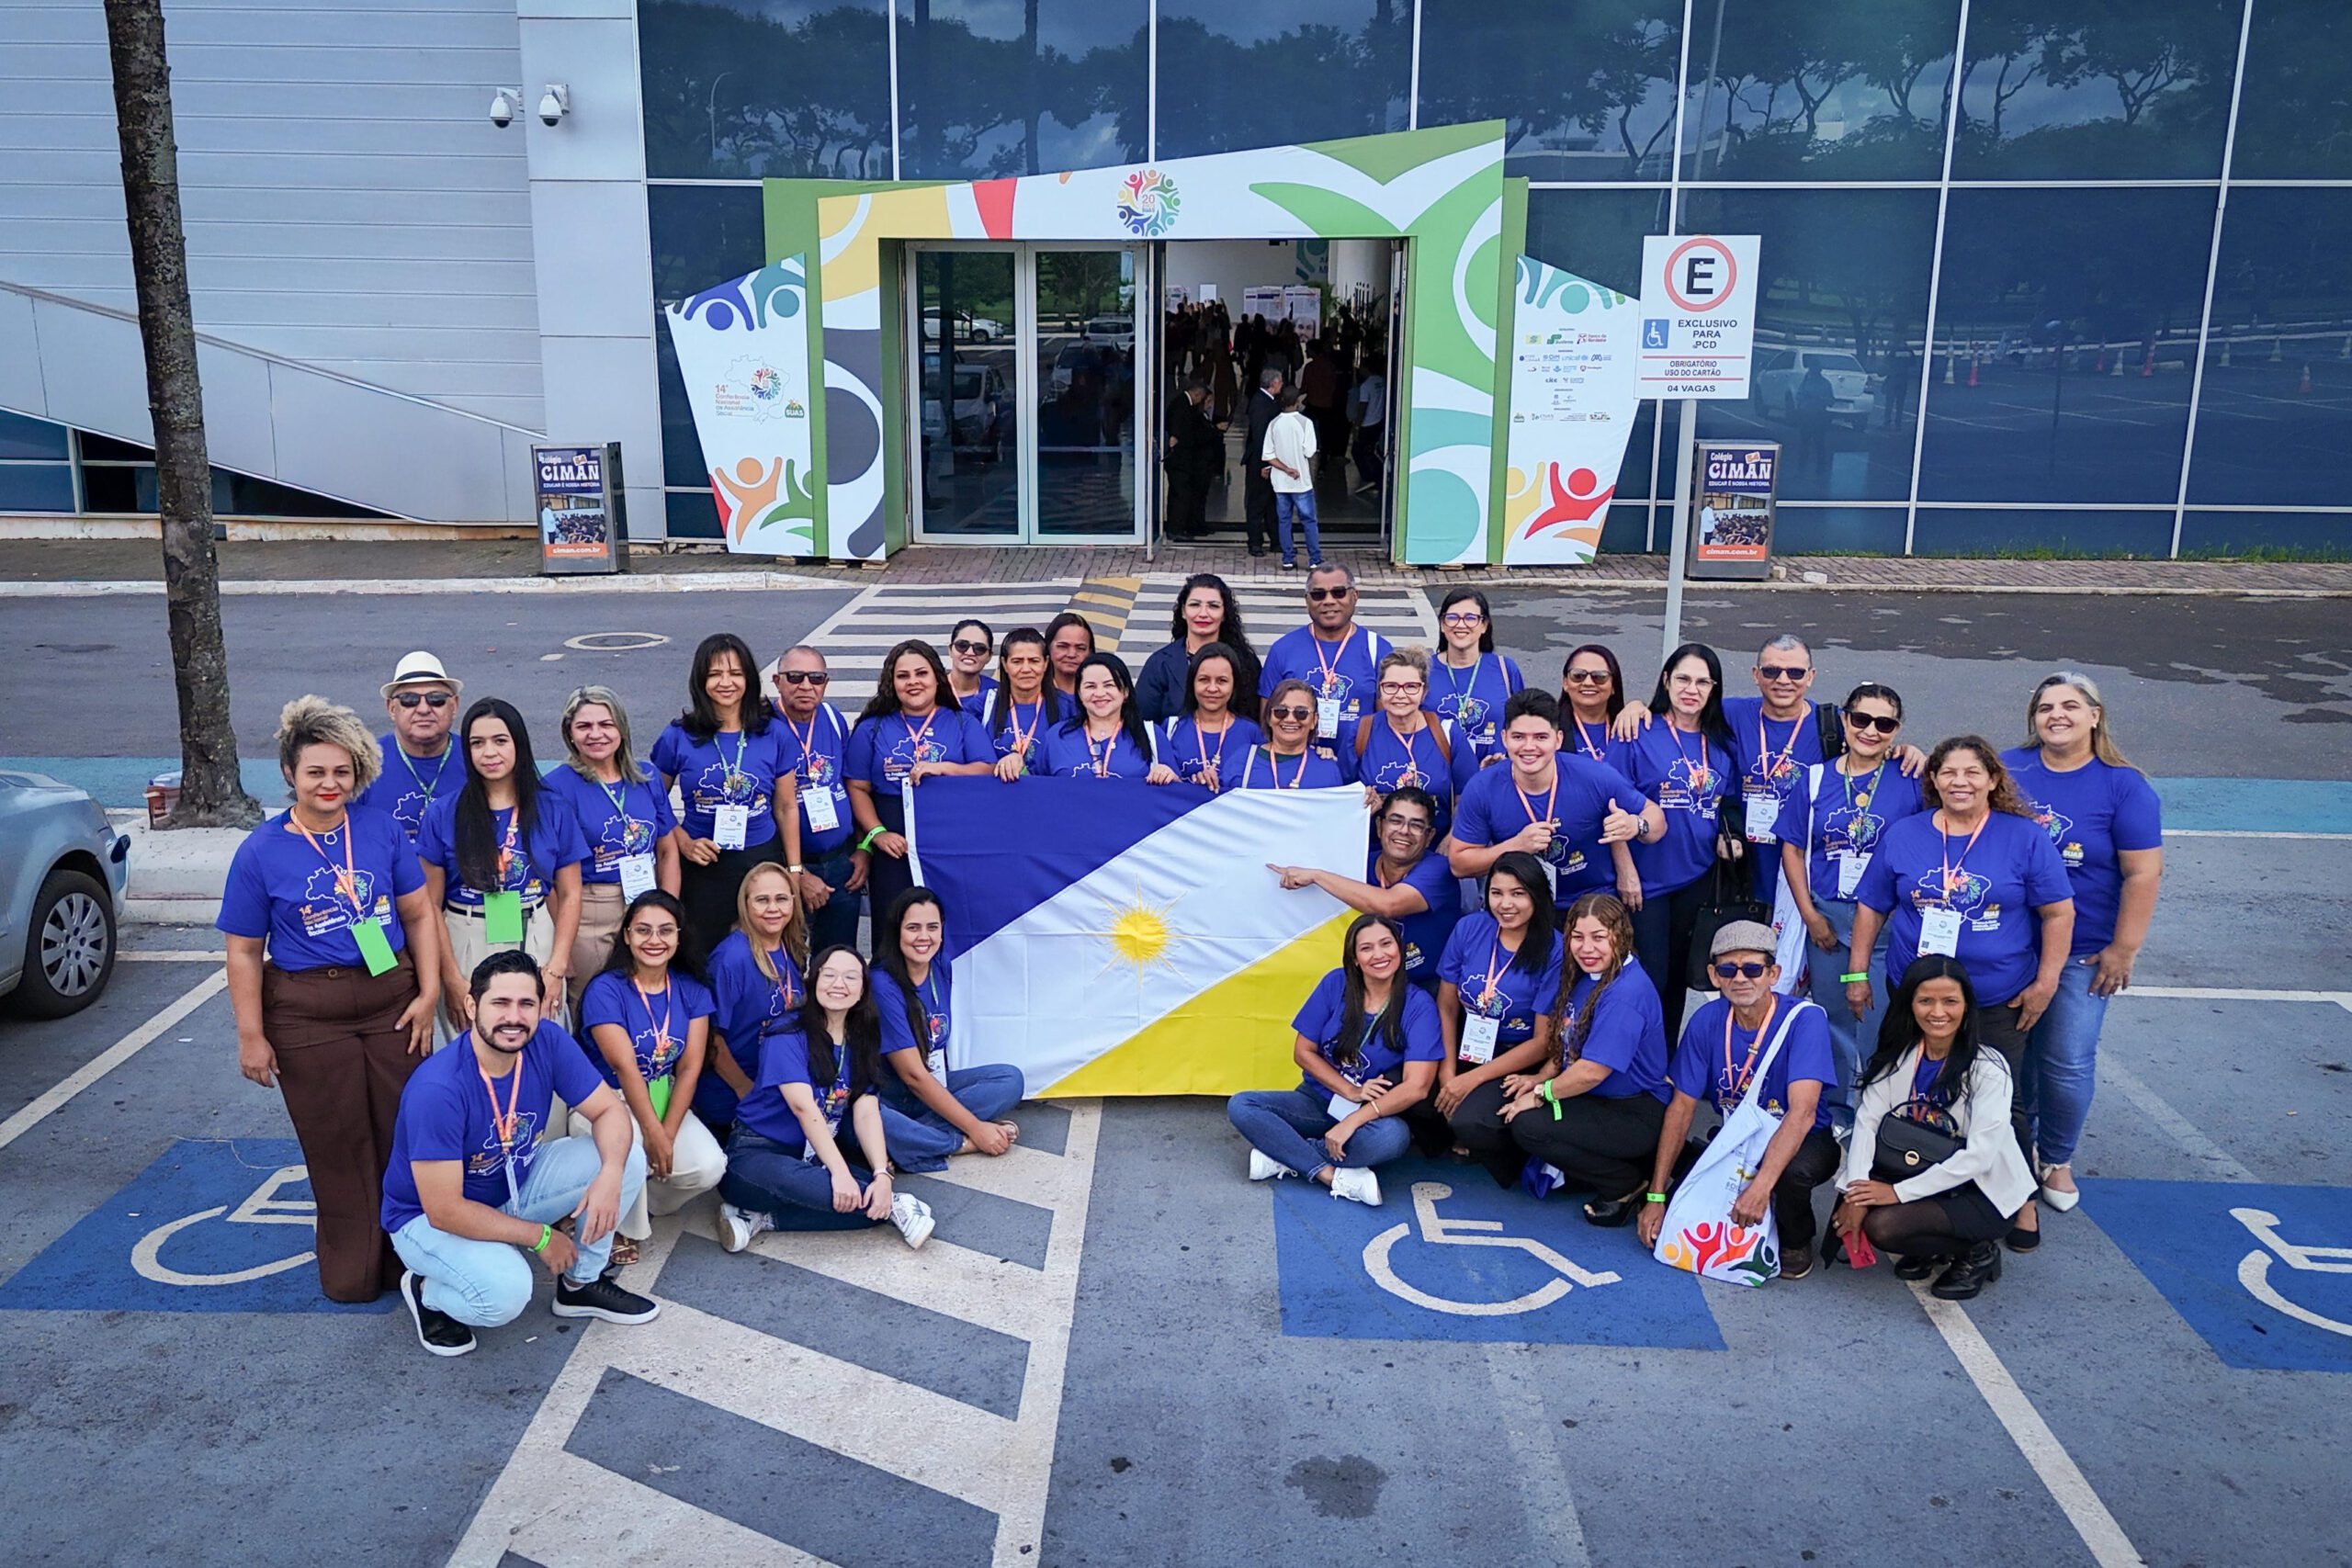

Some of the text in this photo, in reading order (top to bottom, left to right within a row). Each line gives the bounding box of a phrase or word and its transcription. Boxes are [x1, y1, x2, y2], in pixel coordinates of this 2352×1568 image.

[1142, 194, 1155, 204] 20
[1686, 257, 1715, 295] E
[1678, 320, 1737, 328] EXCLUSIVO
[1692, 330, 1721, 338] PARA
[1695, 341, 1717, 349] PCD
[1669, 359, 1717, 367] OBRIGATÓRIO
[1692, 368, 1721, 377] CARTÃO
[1710, 452, 1733, 463] Colégio
[541, 465, 600, 481] CIMAN
[1709, 463, 1772, 479] CIMAN
